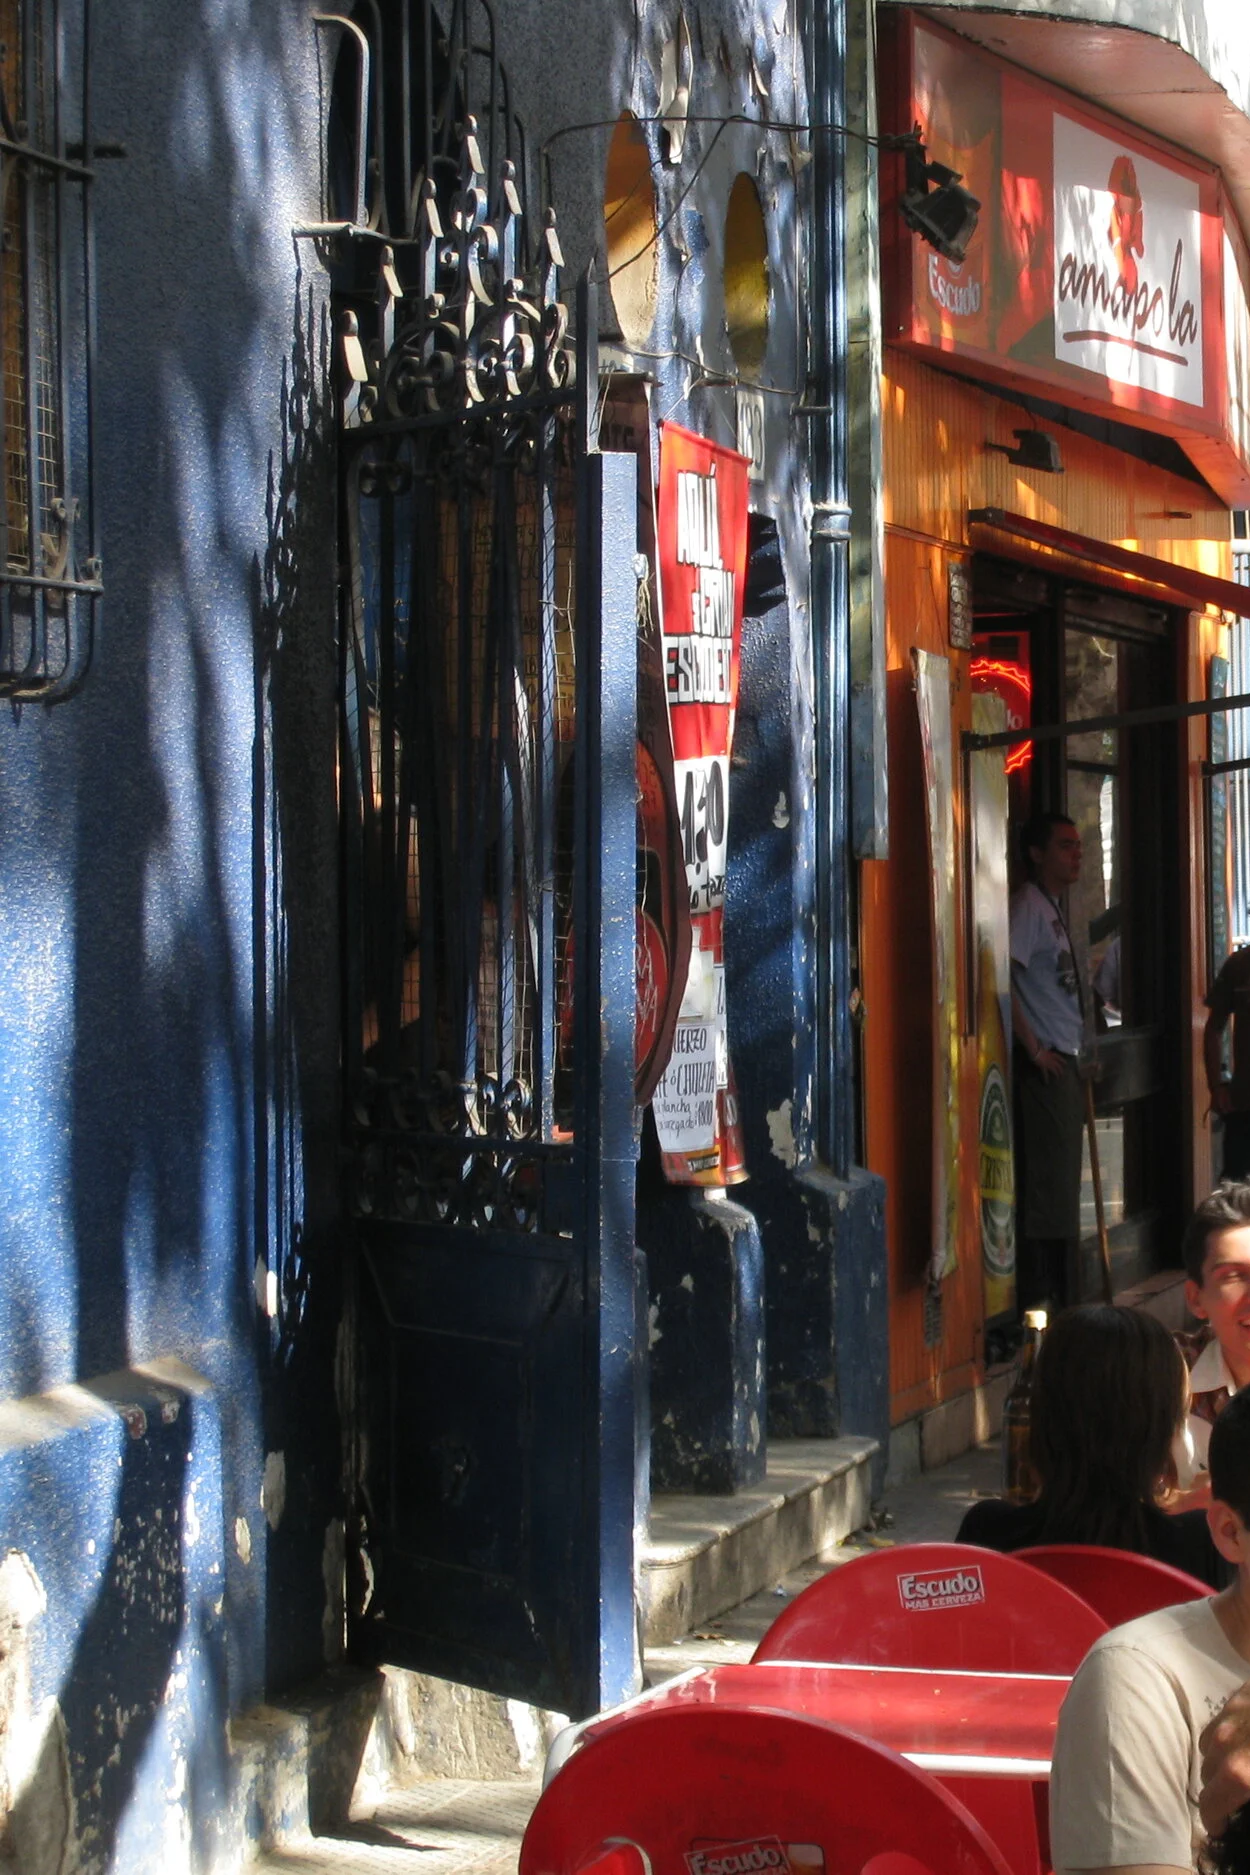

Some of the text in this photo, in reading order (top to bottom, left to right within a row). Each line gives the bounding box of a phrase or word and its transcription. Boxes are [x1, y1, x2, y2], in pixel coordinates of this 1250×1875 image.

[928, 253, 980, 317] Escudo
[1059, 239, 1198, 350] amapola
[674, 1027, 707, 1054] UERZO
[901, 1572, 978, 1600] Escudo
[905, 1592, 981, 1611] MAS CERVEZA
[690, 1843, 781, 1875] Escudo
